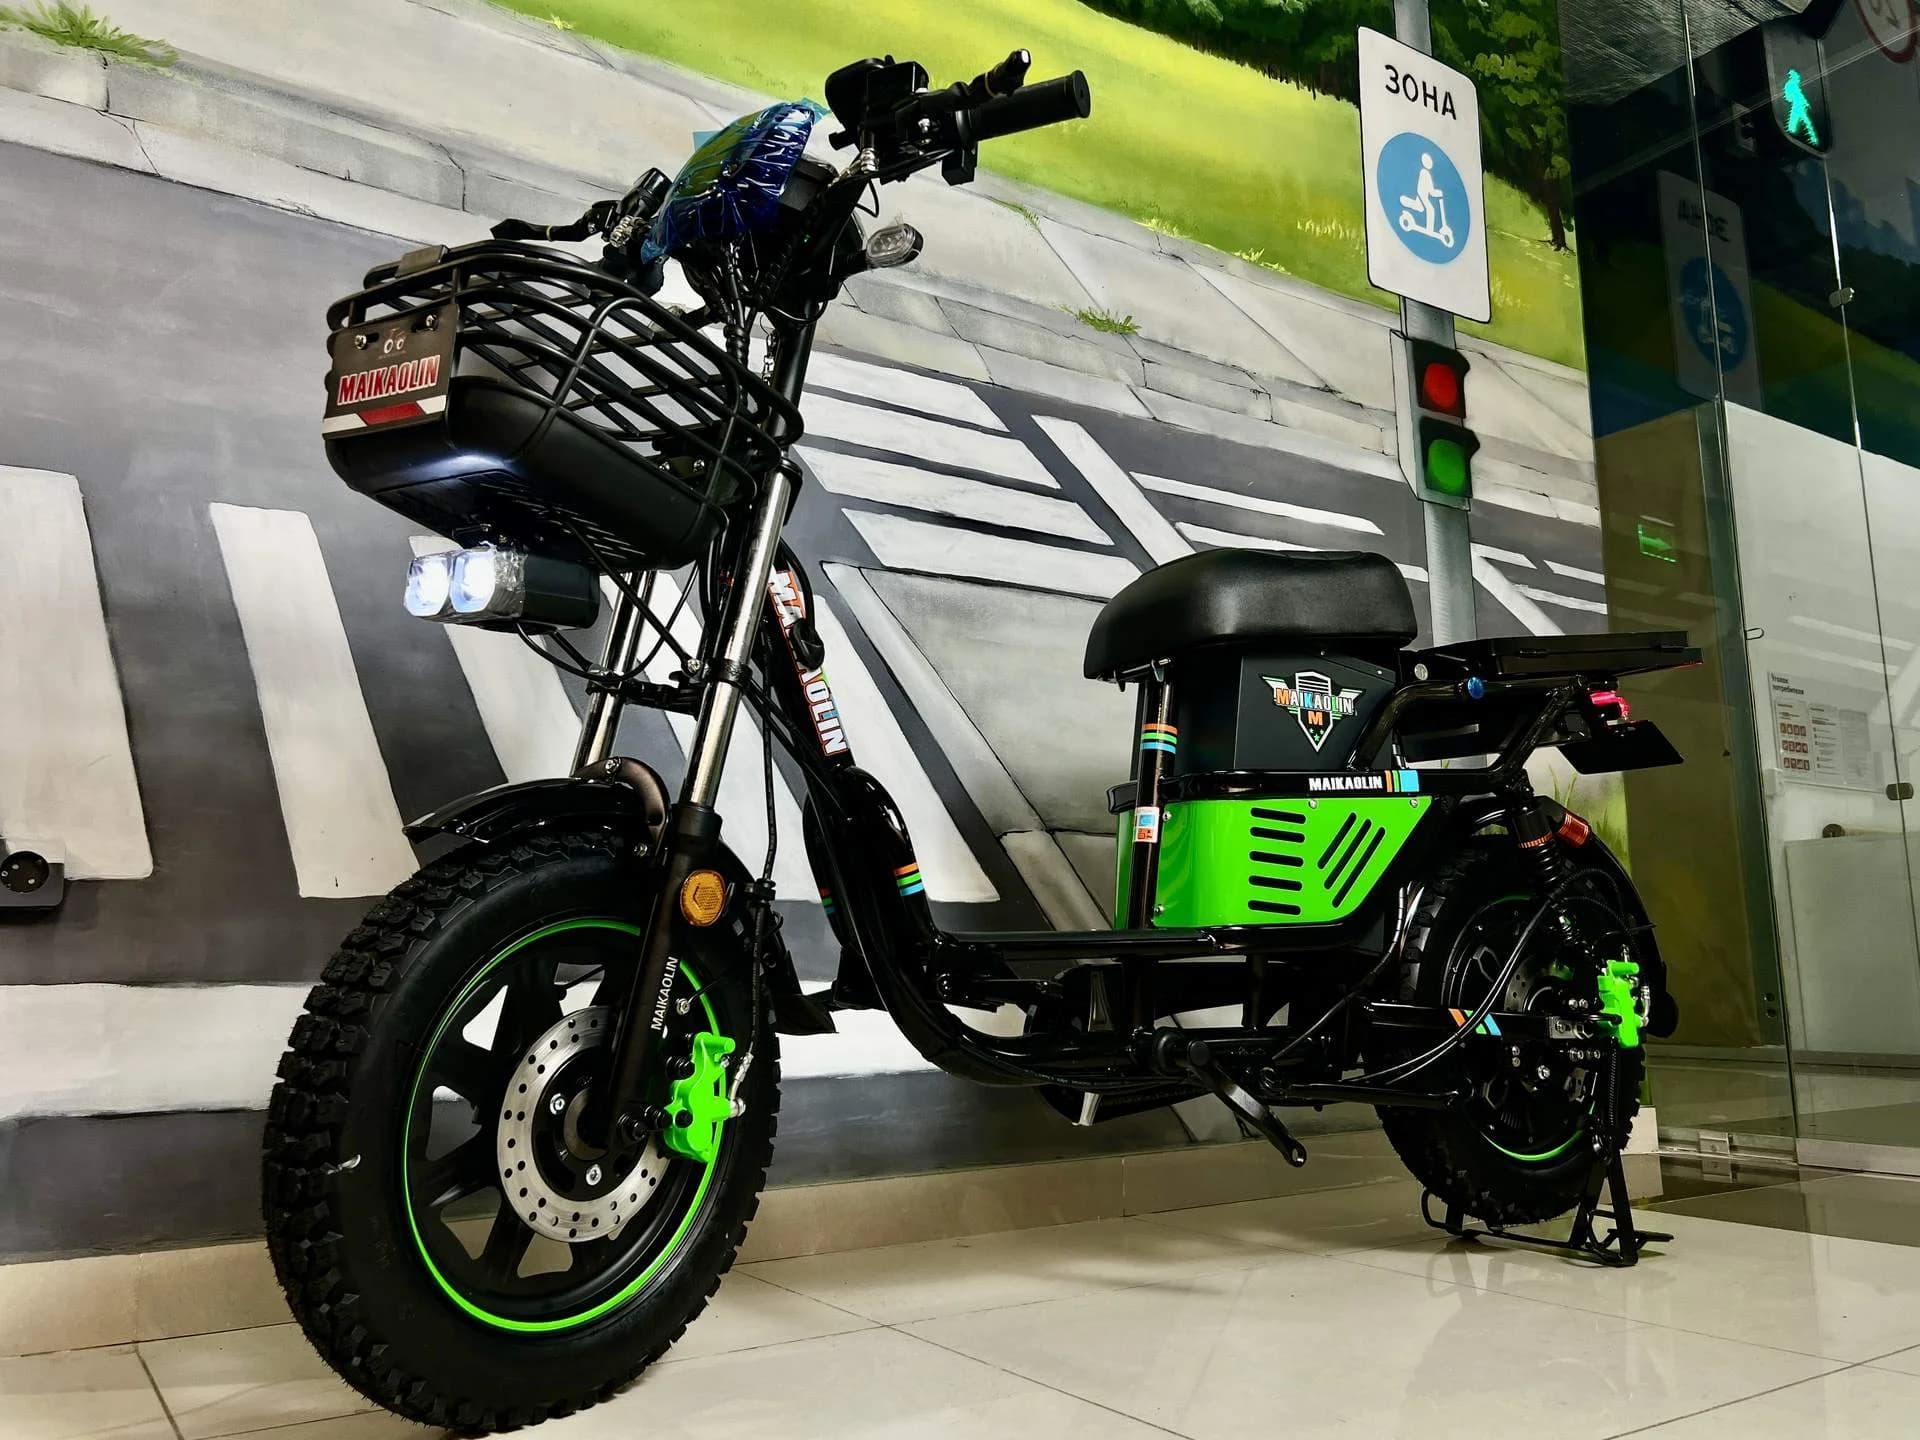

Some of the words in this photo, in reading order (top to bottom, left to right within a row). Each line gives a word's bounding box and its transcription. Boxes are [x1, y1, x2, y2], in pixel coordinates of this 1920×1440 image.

[1384, 64, 1457, 121] ЗОНА
[337, 354, 441, 406] MAIKAOLIN
[1274, 687, 1354, 715] MAIKAOLIN
[1307, 710, 1323, 726] M
[1308, 775, 1383, 791] MAIKAOLIN
[650, 956, 679, 1031] MAIKAOLIN
